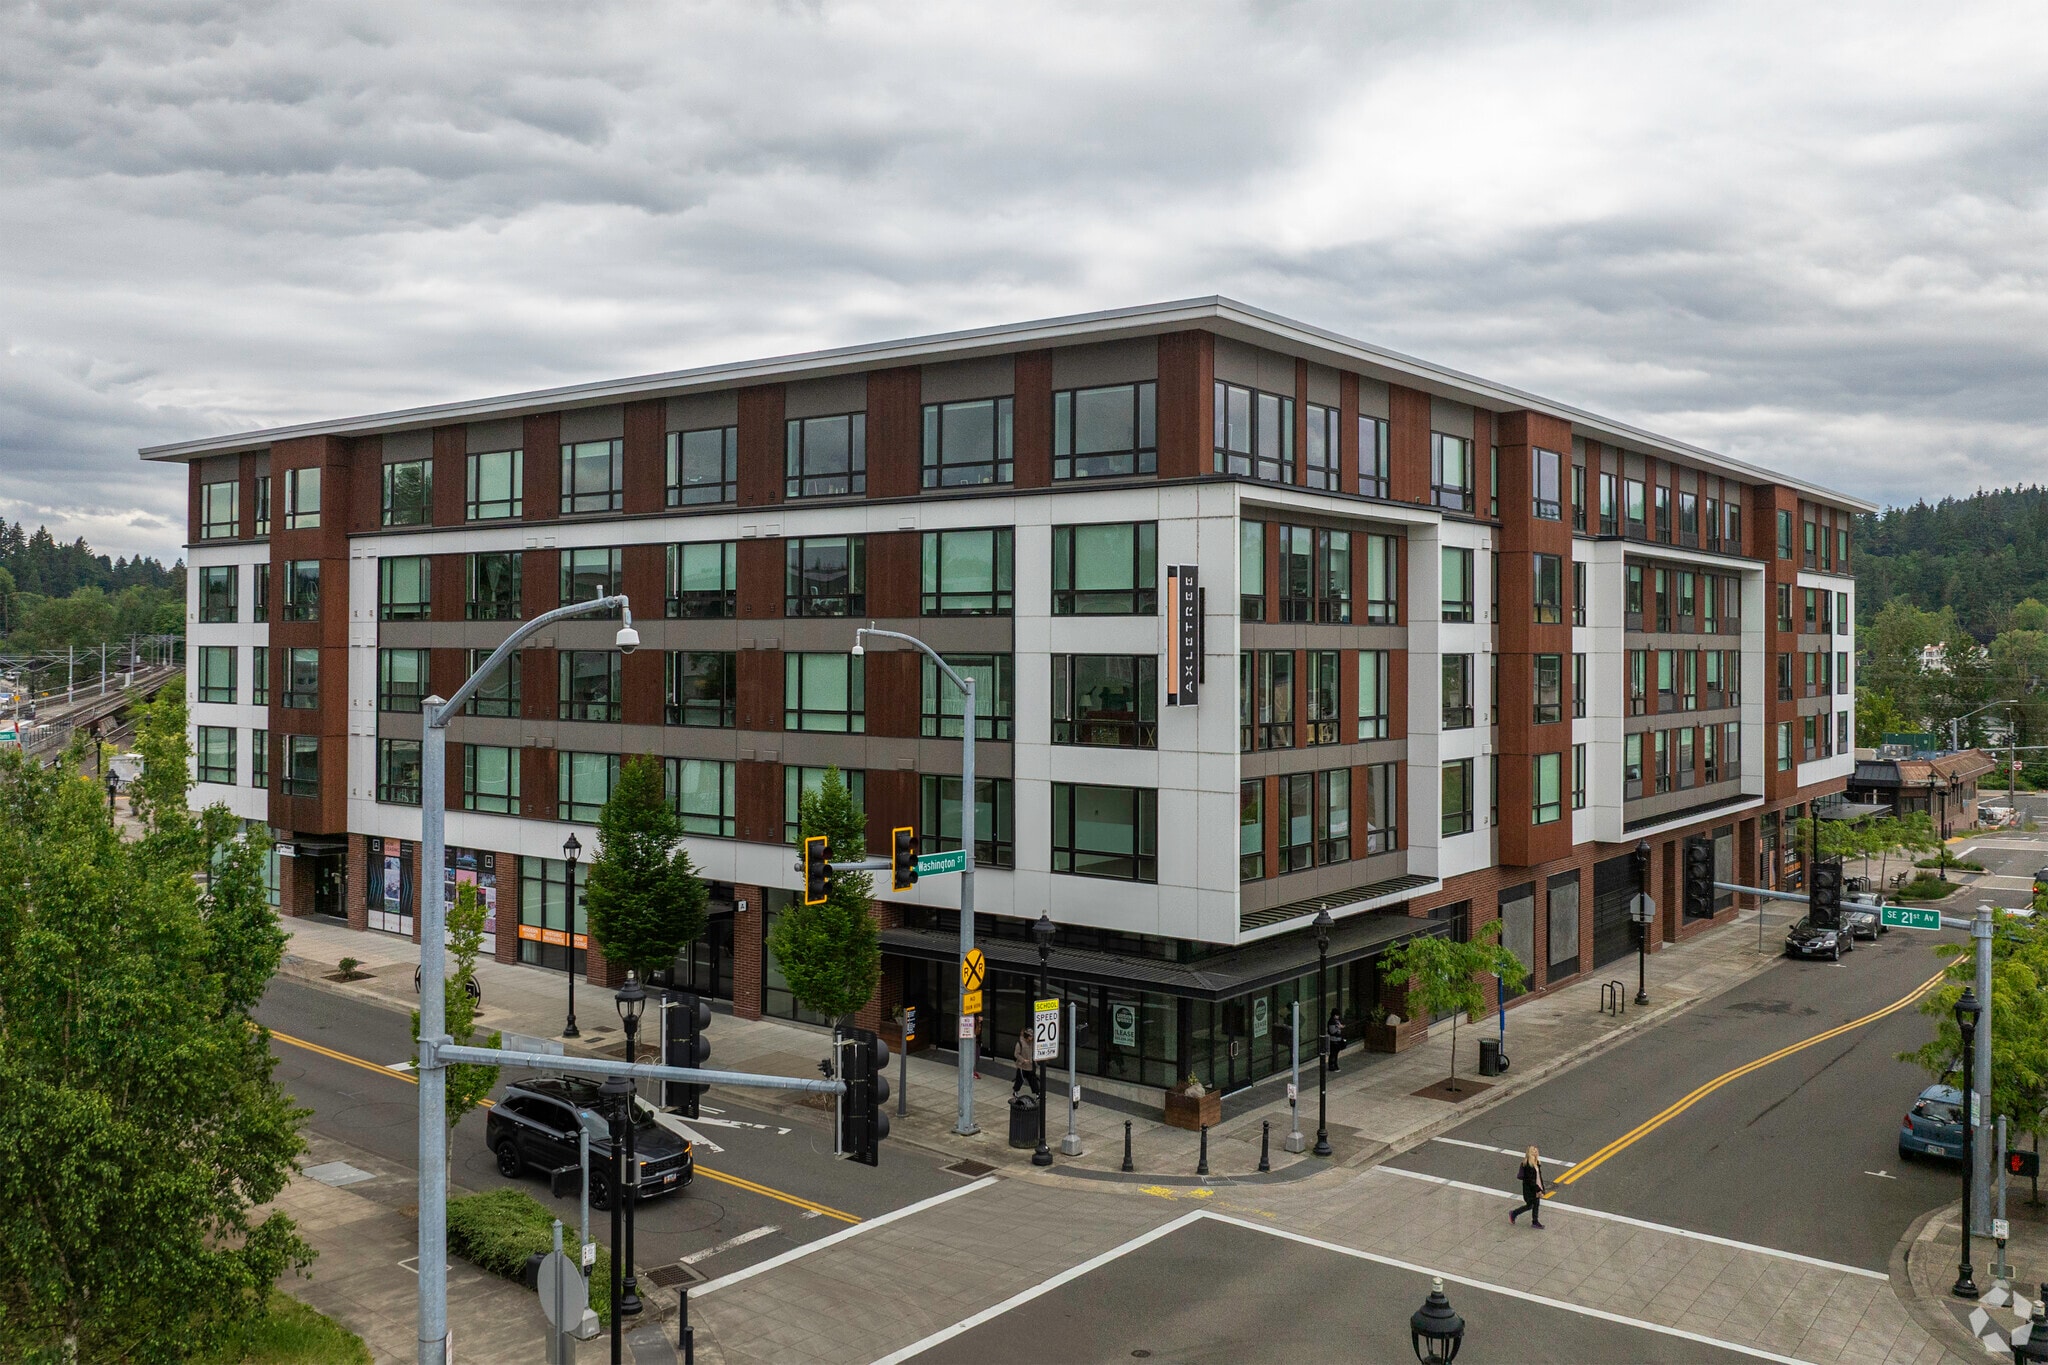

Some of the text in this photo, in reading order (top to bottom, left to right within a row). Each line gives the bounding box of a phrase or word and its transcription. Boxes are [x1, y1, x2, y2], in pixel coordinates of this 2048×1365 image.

[1185, 577, 1193, 693] AXLETREE
[918, 859, 956, 872] Washington
[1887, 911, 1897, 919] SE
[1901, 912, 1920, 924] 21st
[964, 963, 983, 977] R R
[1036, 1001, 1057, 1010] SCHOOL
[1036, 1012, 1058, 1021] SPEED
[1036, 1021, 1057, 1042] 20
